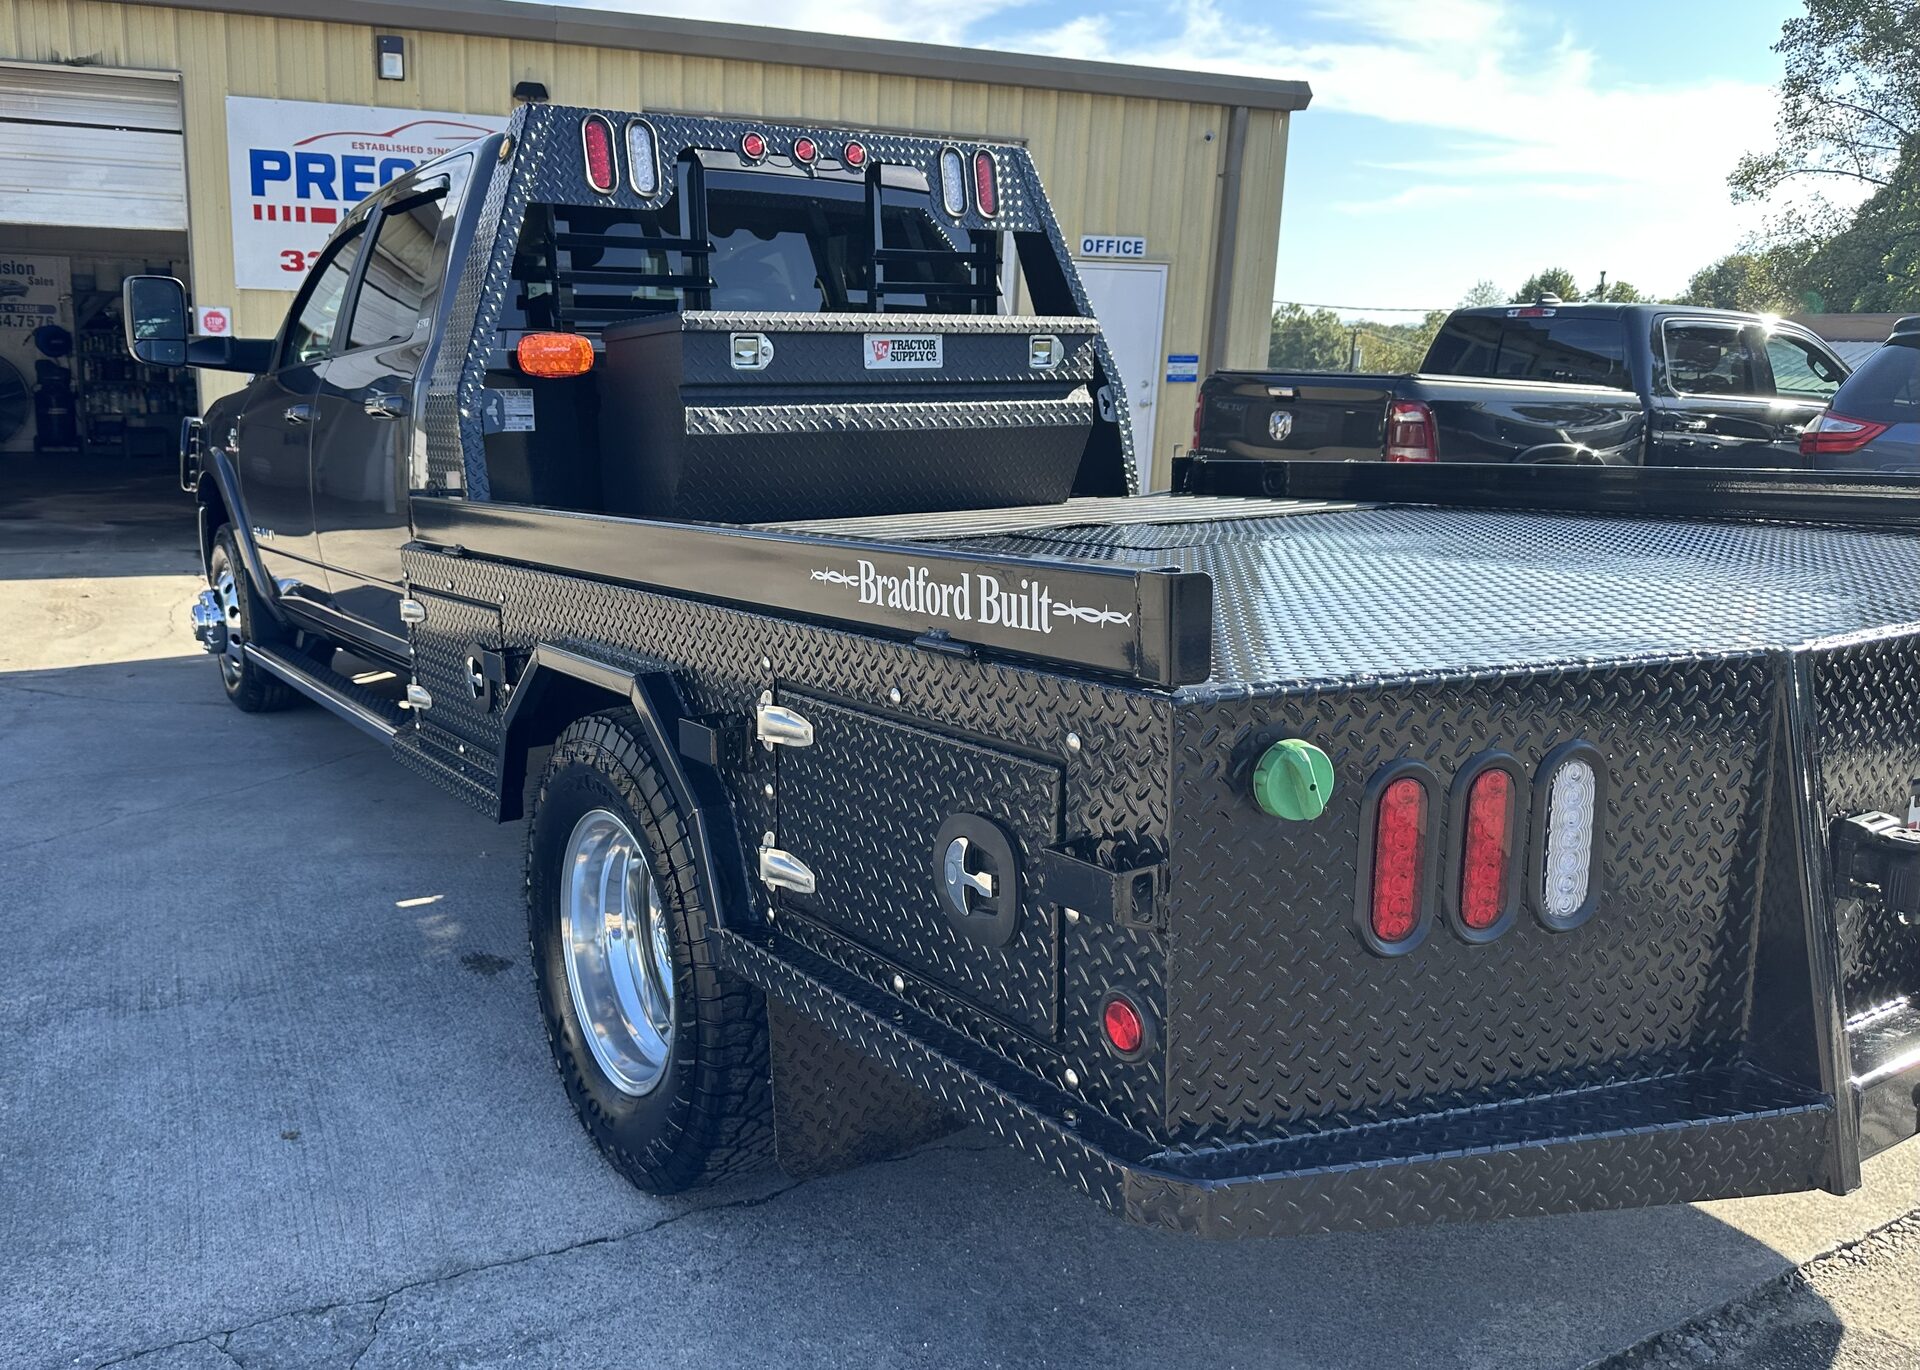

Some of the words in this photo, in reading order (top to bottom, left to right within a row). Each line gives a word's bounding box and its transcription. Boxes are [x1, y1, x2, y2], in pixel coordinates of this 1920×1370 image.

[352, 142, 423, 154] ESTABLISHED
[249, 149, 420, 201] PREC
[1083, 239, 1143, 255] OFFICE
[28, 276, 54, 287] Sales
[206, 317, 223, 326] STOP
[873, 341, 887, 357] TSC
[890, 339, 936, 350] TRACTOR
[890, 351, 925, 362] SUPPLY
[857, 560, 971, 621] Bradford
[977, 575, 1053, 634] Built
